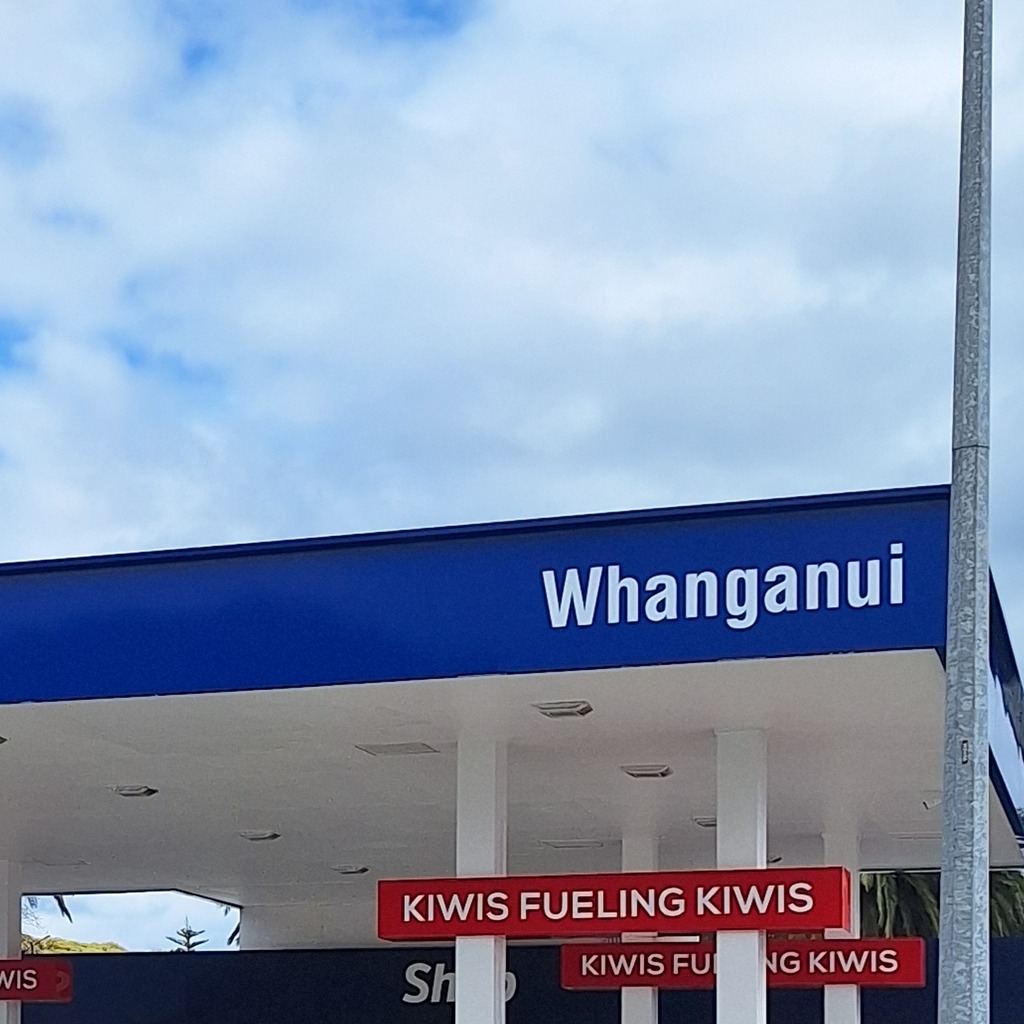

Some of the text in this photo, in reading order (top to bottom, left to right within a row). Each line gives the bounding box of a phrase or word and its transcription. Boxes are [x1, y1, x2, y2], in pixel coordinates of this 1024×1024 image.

[542, 543, 903, 629] Whanganui
[403, 883, 814, 922] KIWIS FUELING KIWIS
[582, 950, 898, 976] KIWIS FUNG KIWIS
[402, 963, 517, 1003] Sh
